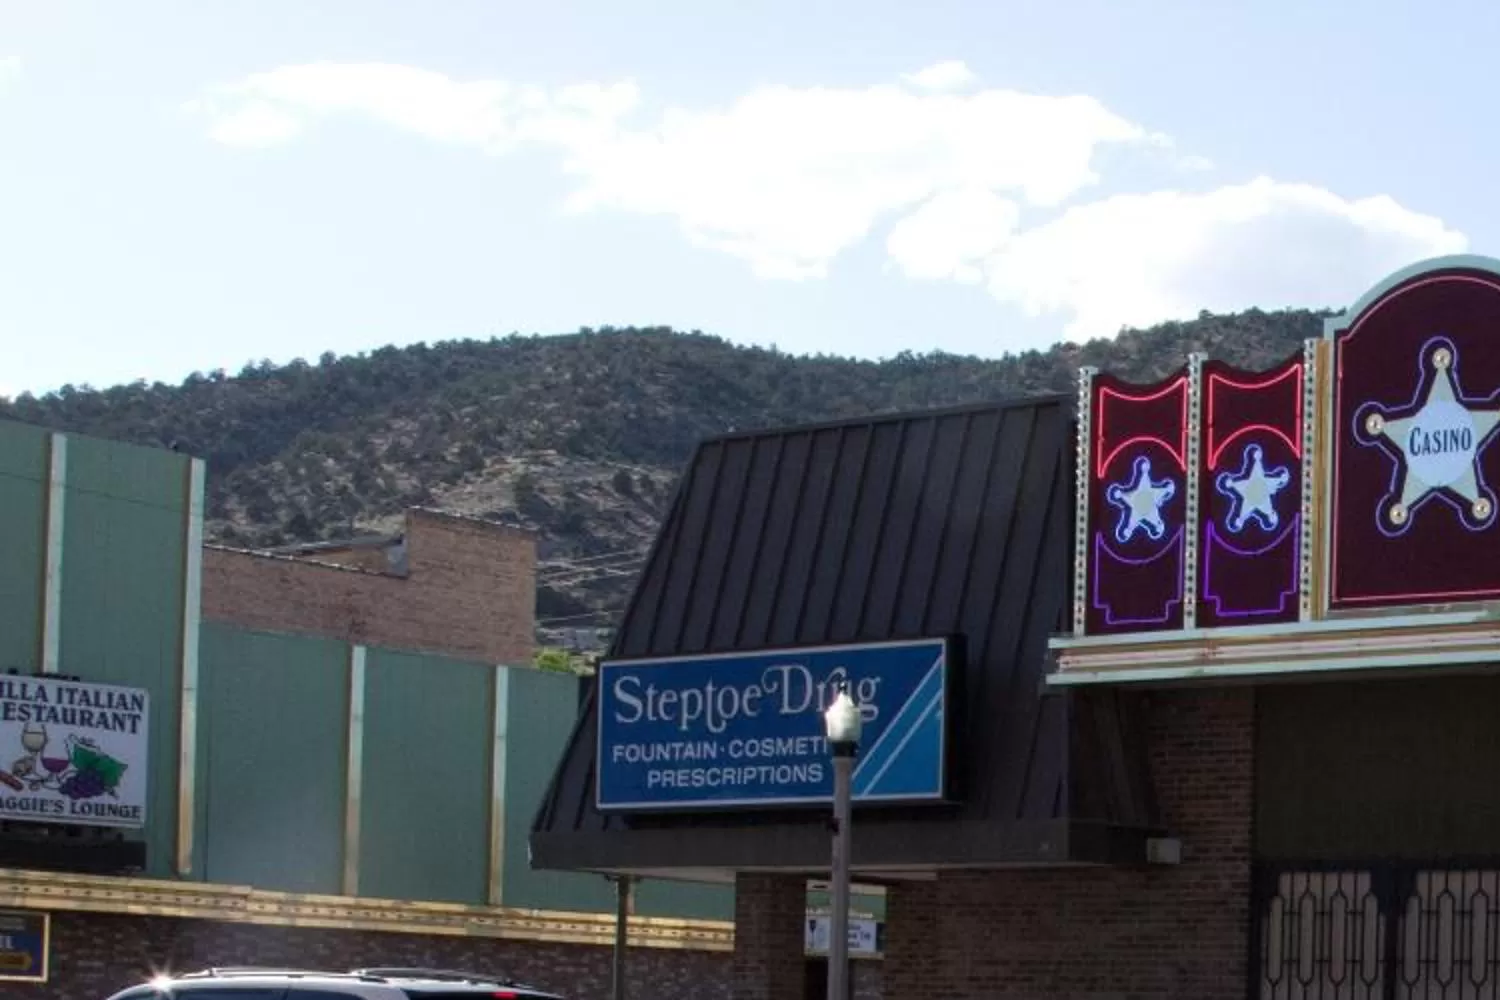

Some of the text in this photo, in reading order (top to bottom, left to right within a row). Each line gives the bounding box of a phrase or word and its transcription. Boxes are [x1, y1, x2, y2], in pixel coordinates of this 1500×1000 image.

[1409, 427, 1472, 456] CASINO
[56, 686, 144, 712] ITALIAN
[613, 675, 762, 733] Steptoe
[2, 701, 141, 734] ESTAURANT
[612, 735, 828, 763] FOUNTAIN COSMETI
[647, 763, 823, 788] PRESCRIPTIONS
[70, 801, 141, 818] LOUNGE
